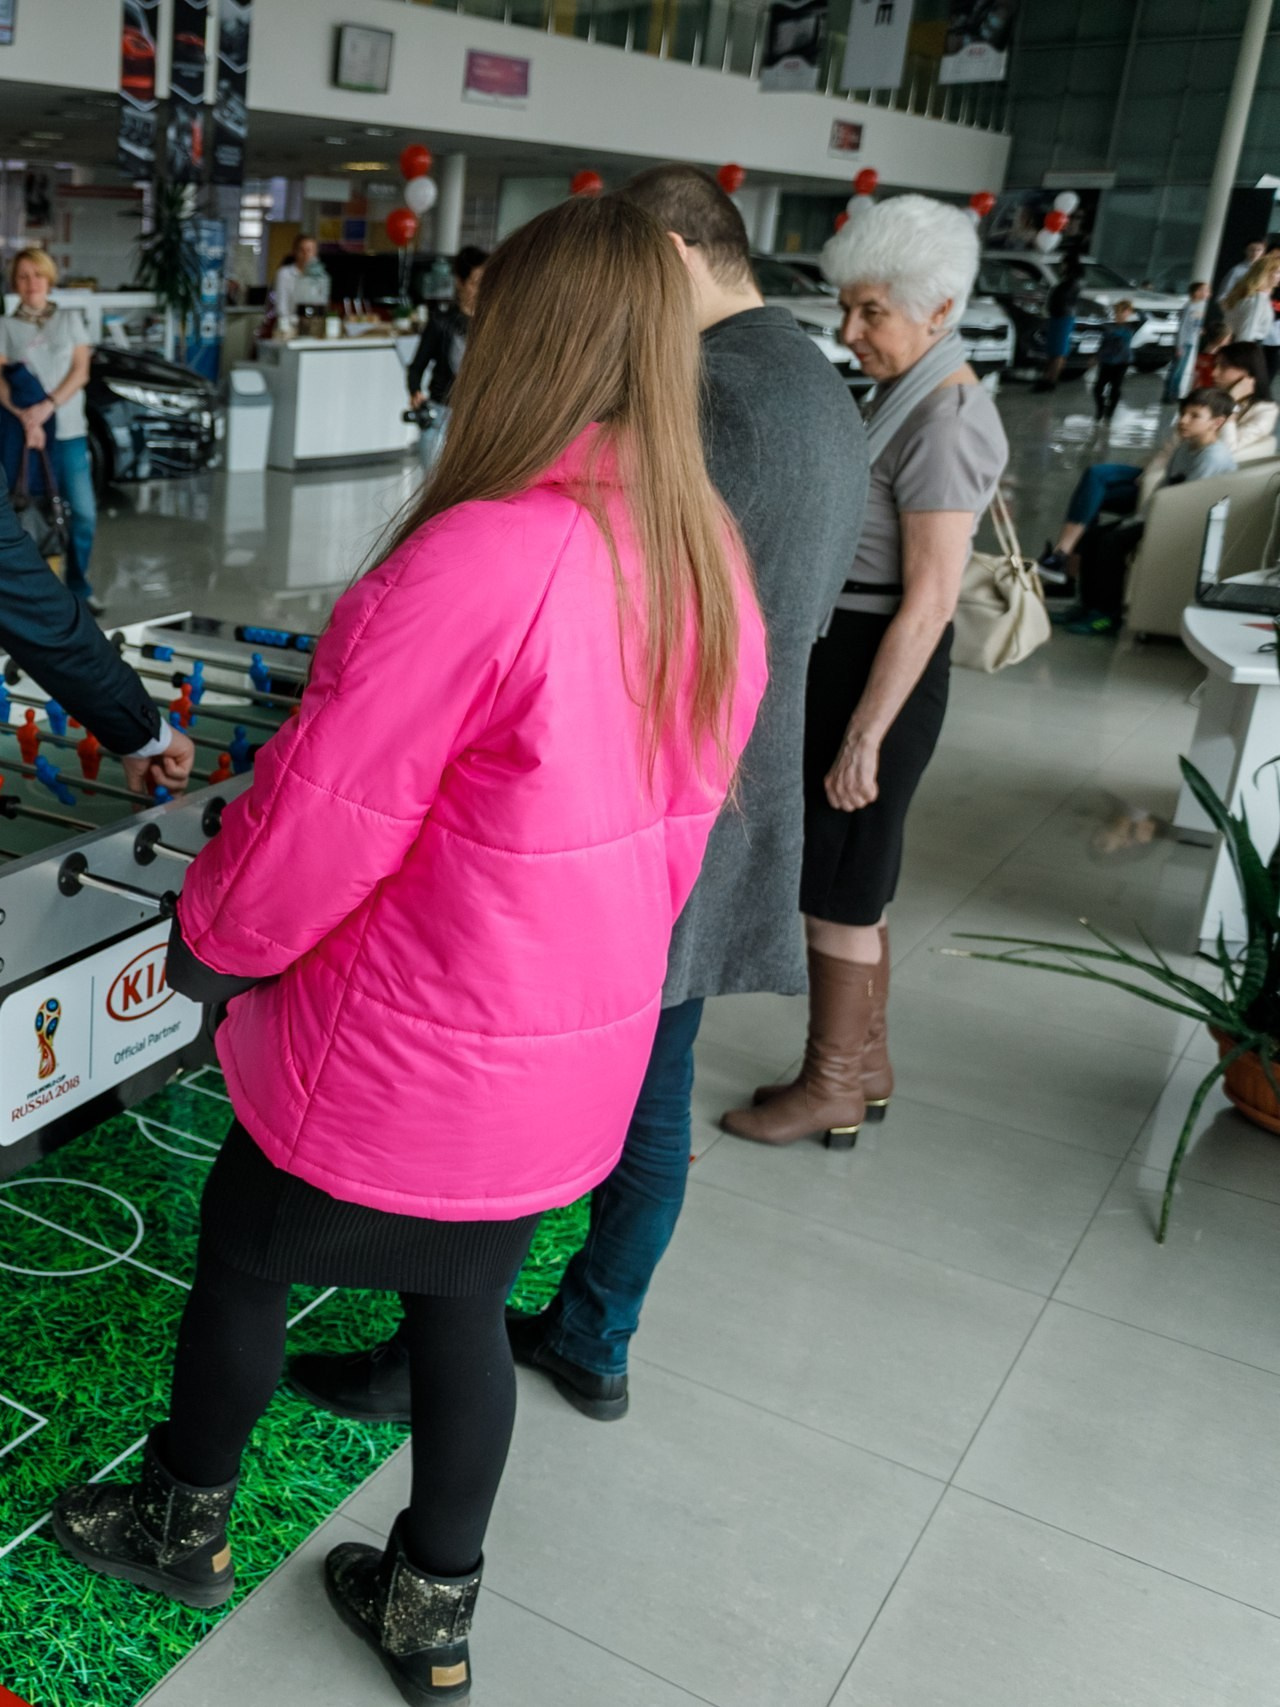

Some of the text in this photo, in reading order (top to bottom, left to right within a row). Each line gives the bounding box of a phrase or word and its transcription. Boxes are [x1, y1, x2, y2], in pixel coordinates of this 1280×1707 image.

[113, 1020, 182, 1065] Official Partner
[11, 1075, 81, 1122] RUSSIA 2018
